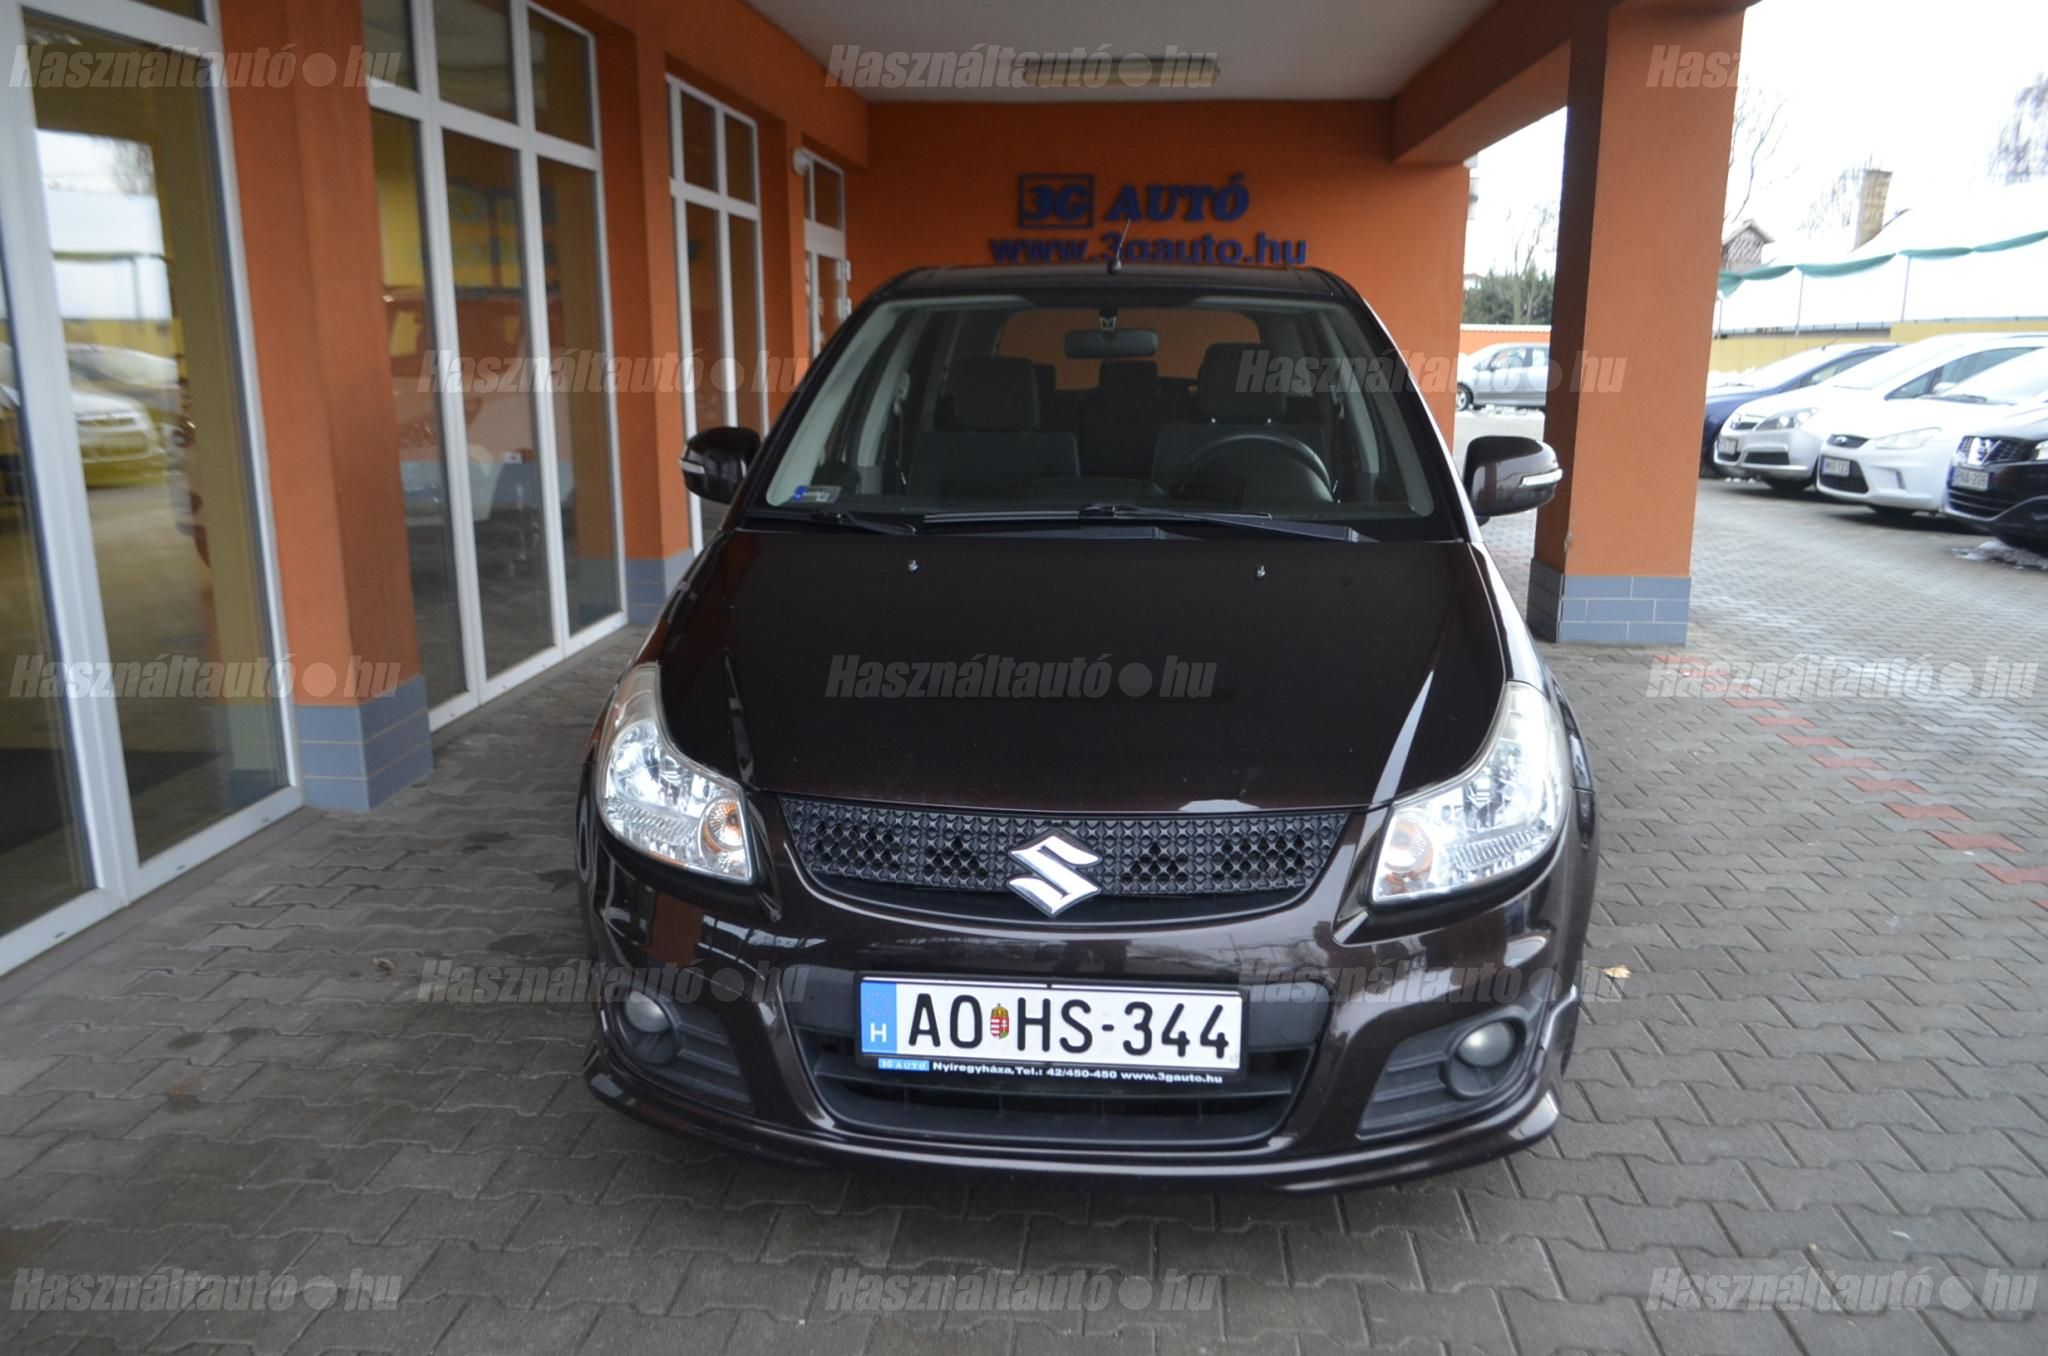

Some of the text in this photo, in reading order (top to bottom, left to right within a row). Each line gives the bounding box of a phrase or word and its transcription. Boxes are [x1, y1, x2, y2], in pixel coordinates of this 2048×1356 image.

[1022, 172, 1250, 222] 3G AUTÓ
[870, 1023, 887, 1043] H
[908, 993, 1230, 1059] AO HS-344
[1046, 1067, 1118, 1080] 42/450-450
[1121, 1071, 1223, 1084] www.3gauto.hu
